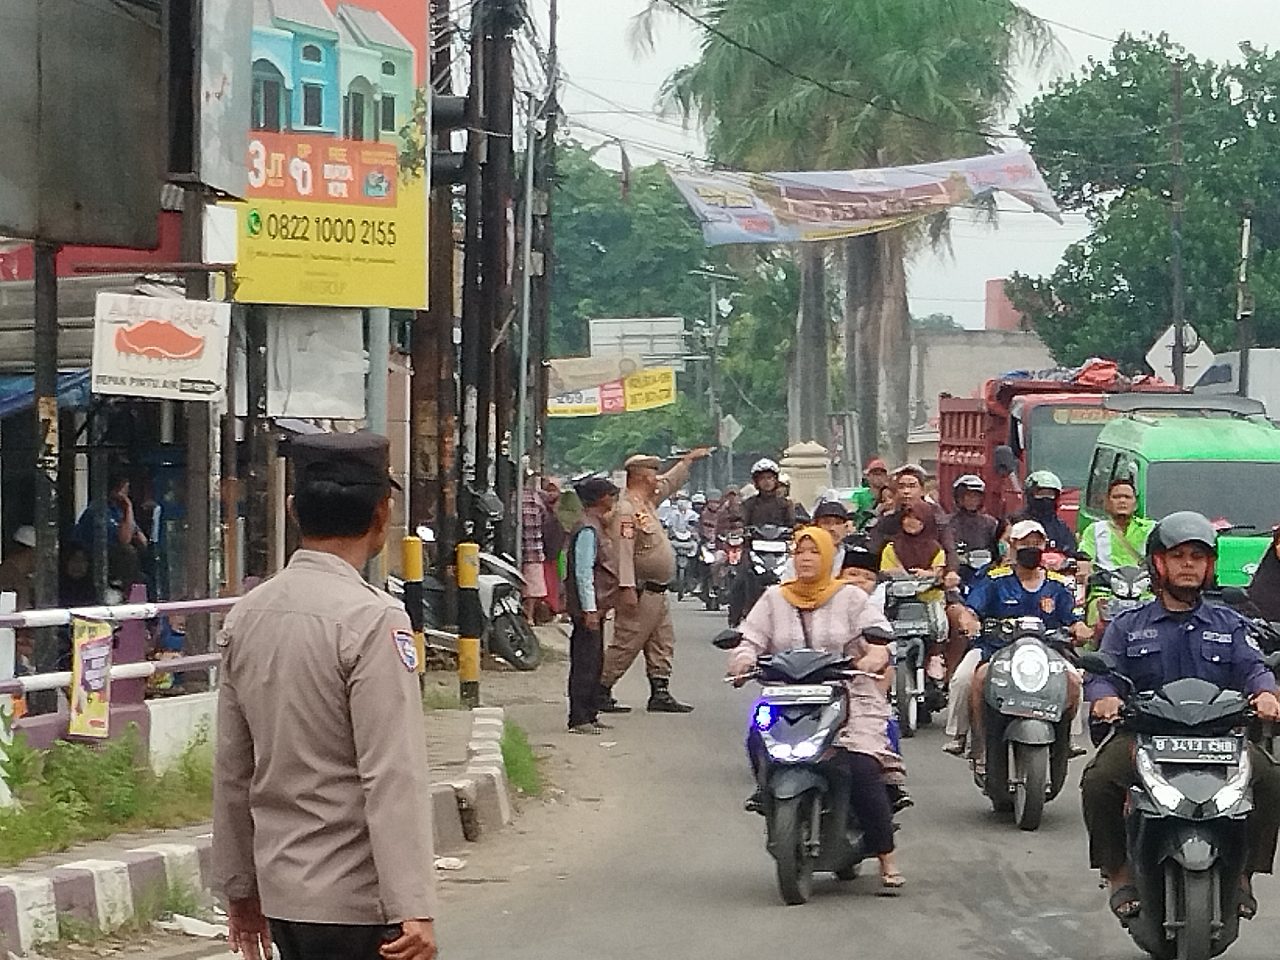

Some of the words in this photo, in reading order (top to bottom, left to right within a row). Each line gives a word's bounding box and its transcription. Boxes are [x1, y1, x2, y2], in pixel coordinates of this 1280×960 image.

[267, 213, 310, 242] 0822
[314, 216, 356, 244] 1000
[360, 219, 397, 247] 2155
